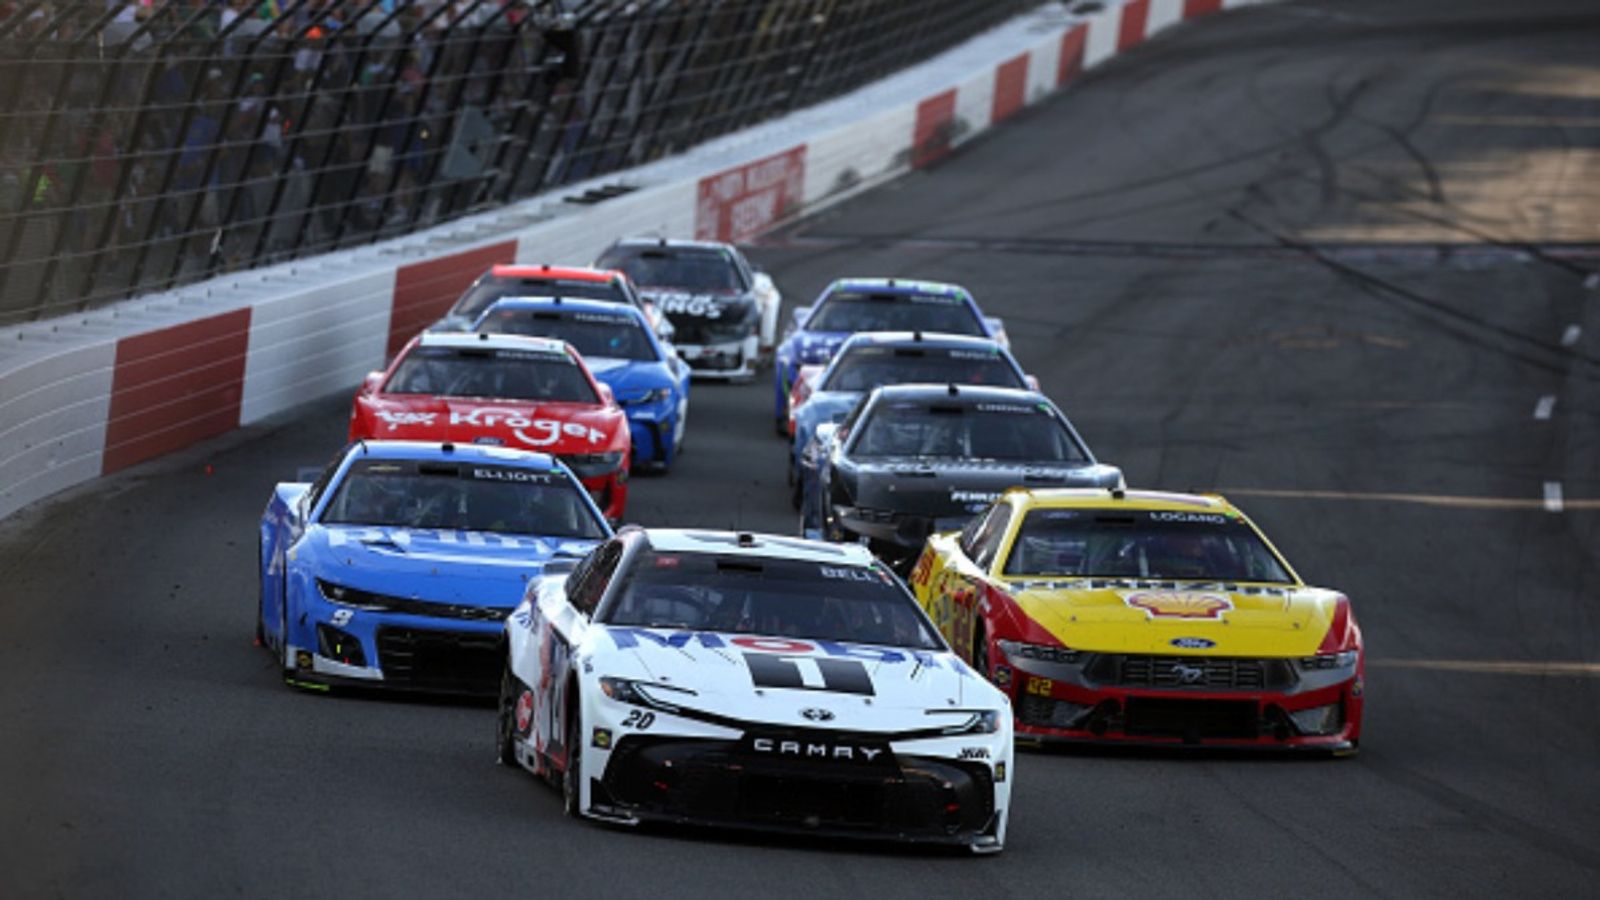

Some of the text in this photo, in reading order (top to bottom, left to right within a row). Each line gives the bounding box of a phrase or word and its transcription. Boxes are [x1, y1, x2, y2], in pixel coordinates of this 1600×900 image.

[450, 407, 607, 446] Kroger
[473, 468, 551, 483] ELLIOTT
[951, 491, 1005, 501] PENNZ
[1150, 513, 1227, 525] LOGANO
[330, 608, 354, 628] 9
[778, 657, 827, 688] 1
[1027, 676, 1053, 697] 22
[620, 708, 656, 730] 20
[753, 738, 882, 760] CAMRY
